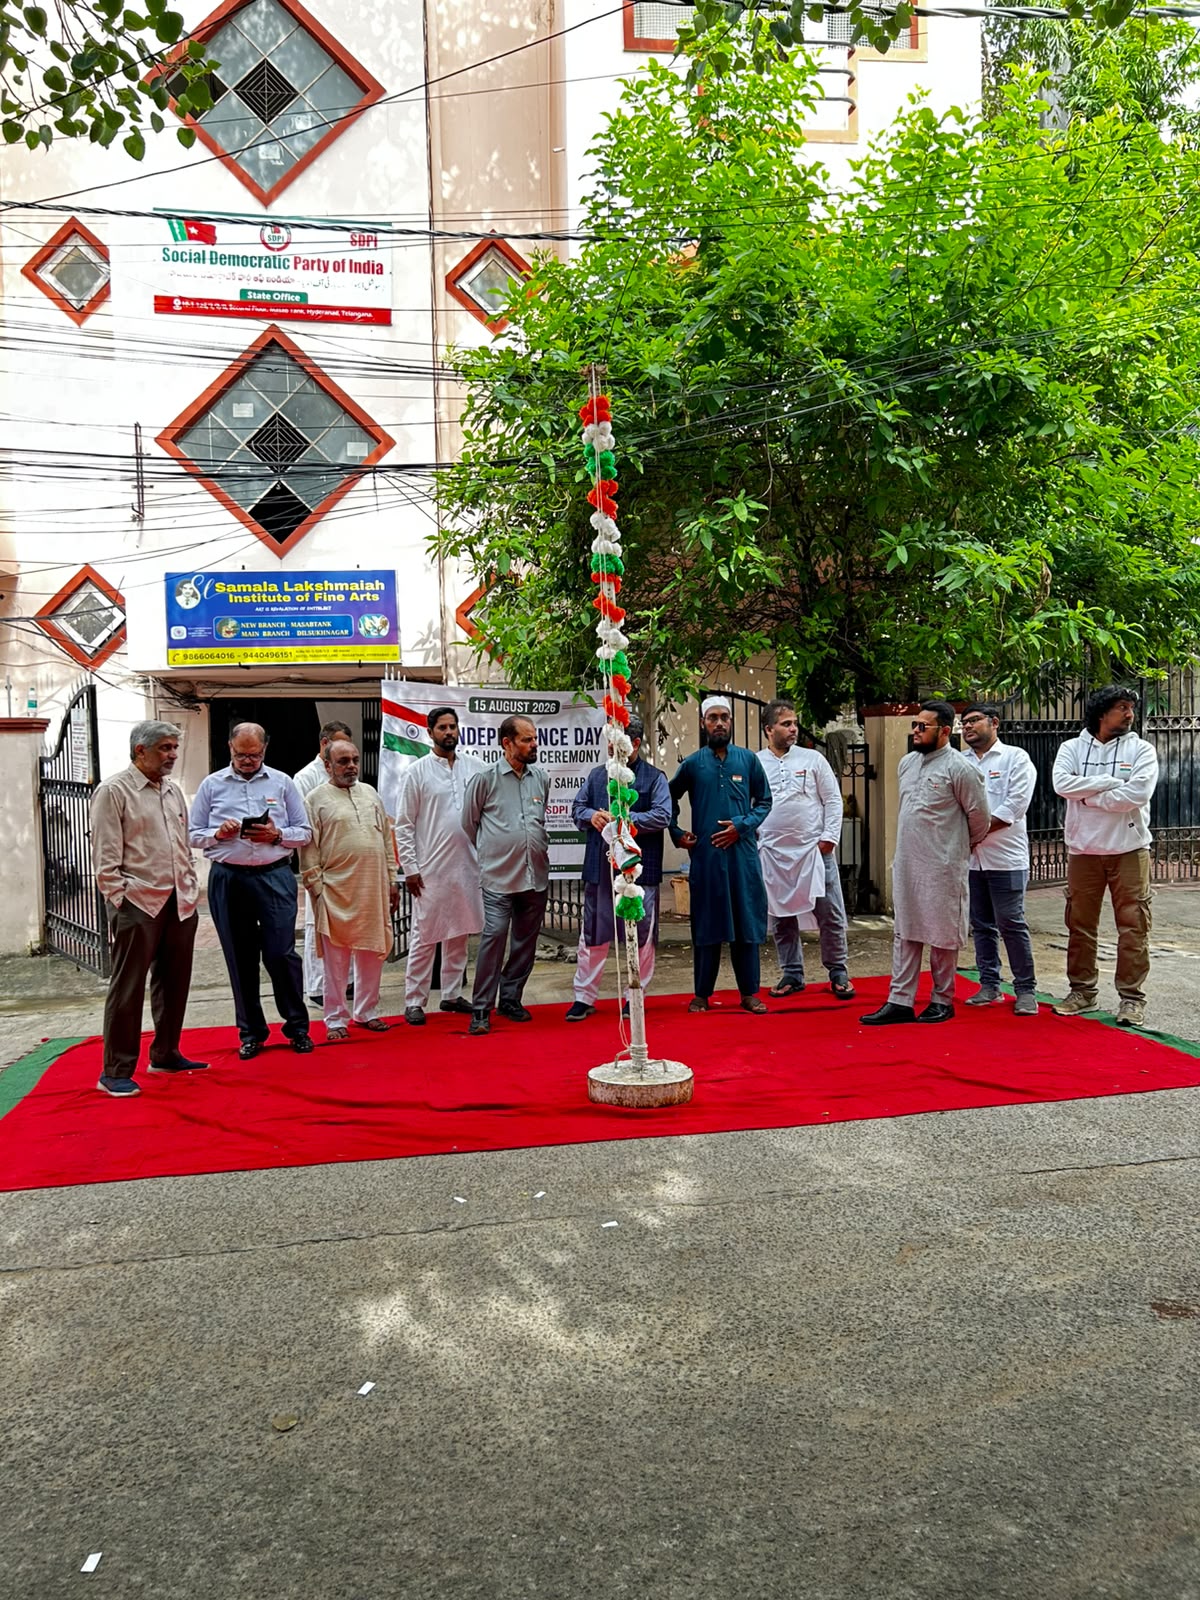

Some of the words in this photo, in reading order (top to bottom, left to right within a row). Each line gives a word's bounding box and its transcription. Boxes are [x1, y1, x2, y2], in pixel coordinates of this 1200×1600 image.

[268, 234, 285, 243] SDPI
[350, 233, 378, 247] SDPI
[162, 247, 206, 264] Social
[209, 250, 290, 269] Democratic
[294, 256, 330, 273] Party
[333, 259, 346, 272] of
[349, 259, 383, 275] India
[247, 291, 271, 300] State
[272, 293, 301, 302] Office
[214, 581, 279, 593] Samala
[283, 580, 385, 592] Lakshmaiah
[228, 593, 292, 603] Institute
[295, 592, 310, 602] of
[314, 592, 346, 602] Fine
[349, 592, 380, 602] Arts
[258, 621, 286, 629] BRANCH
[296, 629, 349, 638] DILSUKHNAGAR
[183, 652, 236, 660] 9866064016
[243, 651, 293, 659] 9440496151
[474, 699, 487, 711] 15
[489, 701, 530, 712] AUGUST
[532, 702, 556, 713] 2026
[575, 727, 602, 746] DAY
[539, 749, 601, 764] CEREMONY
[546, 805, 568, 815] SDPI
